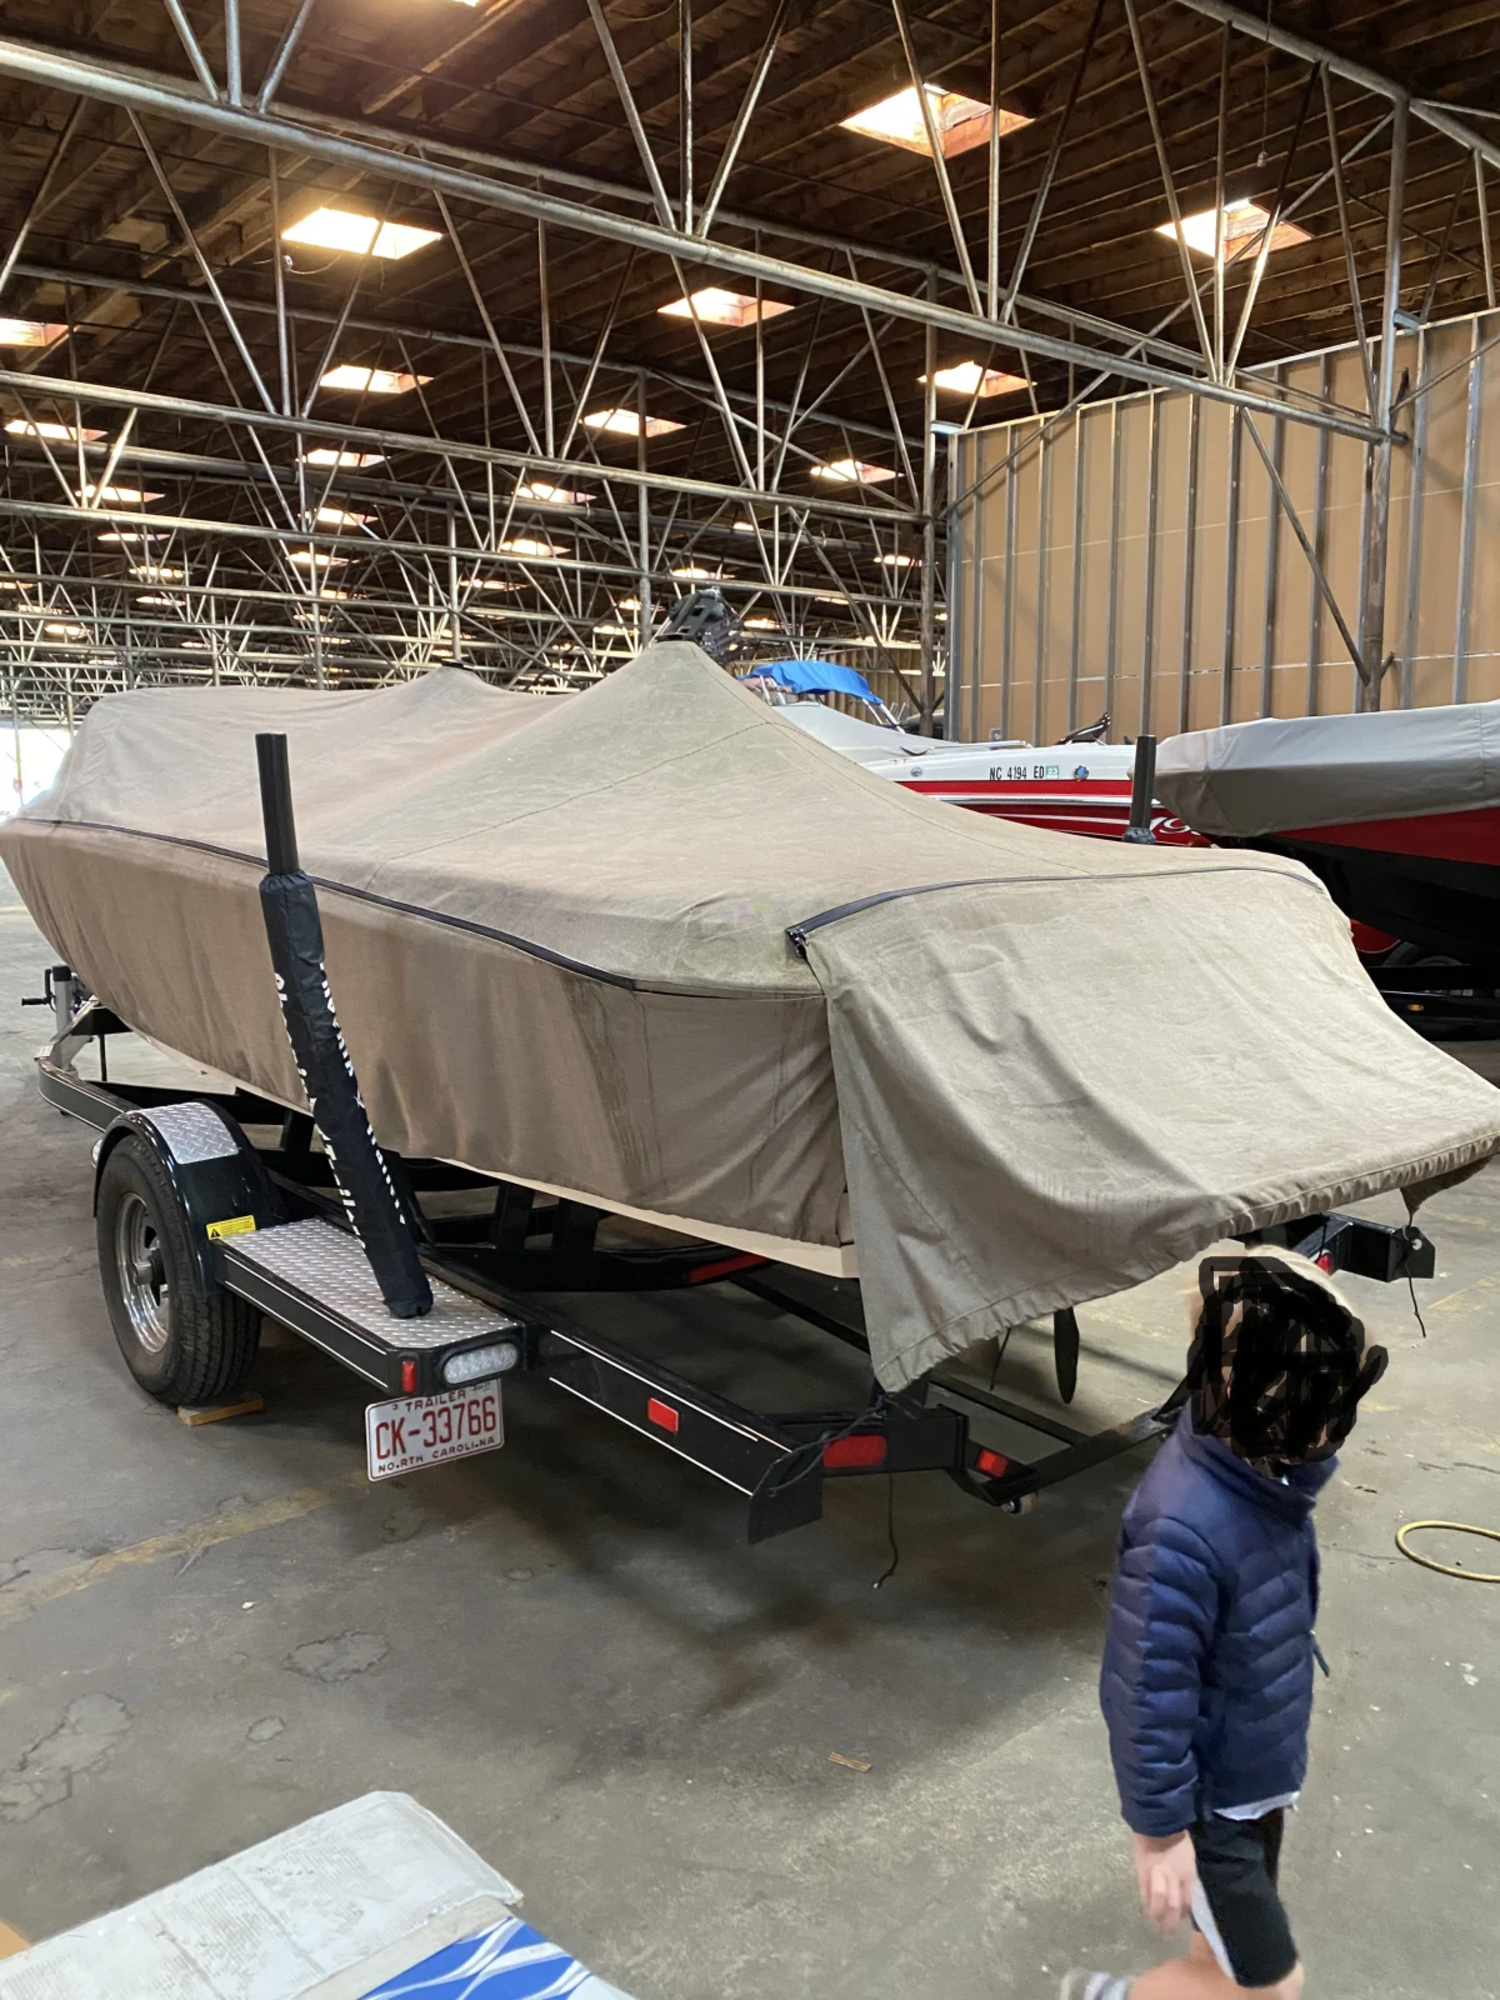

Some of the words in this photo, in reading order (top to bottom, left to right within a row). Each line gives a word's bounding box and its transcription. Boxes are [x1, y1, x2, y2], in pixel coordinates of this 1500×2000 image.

[990, 766, 1002, 780] NC
[1007, 765, 1027, 780] 4194
[1033, 765, 1045, 779] ED
[405, 1389, 466, 1412] TRAILER
[375, 1395, 496, 1460] CK-33766
[378, 1454, 424, 1473] NORTH
[432, 1436, 495, 1459] CAROLINA
